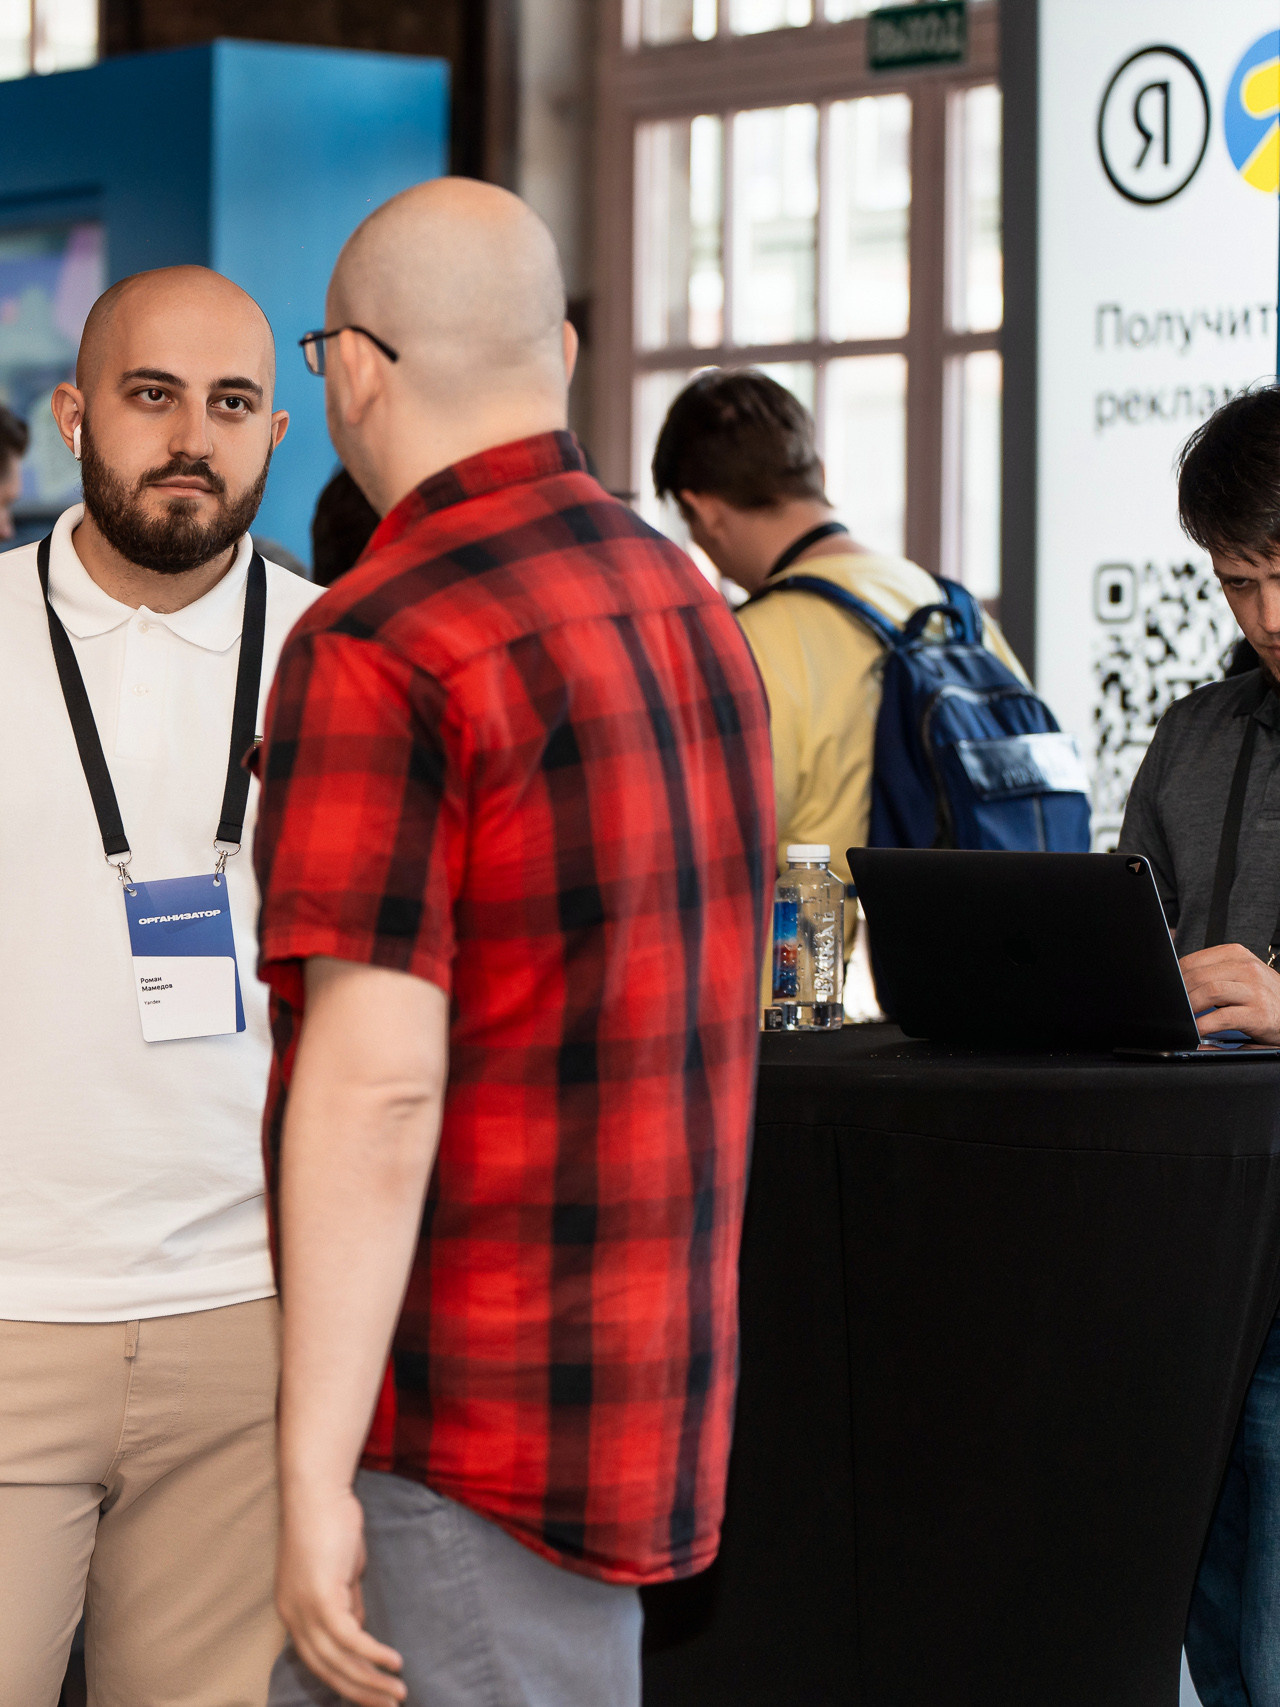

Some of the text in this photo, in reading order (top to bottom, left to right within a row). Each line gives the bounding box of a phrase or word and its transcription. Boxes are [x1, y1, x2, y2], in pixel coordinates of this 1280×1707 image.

[1133, 80, 1171, 171] Я
[138, 909, 221, 925] ОРГАНИЗАТОР
[140, 976, 162, 984] Роман
[141, 983, 173, 992] Мамедов
